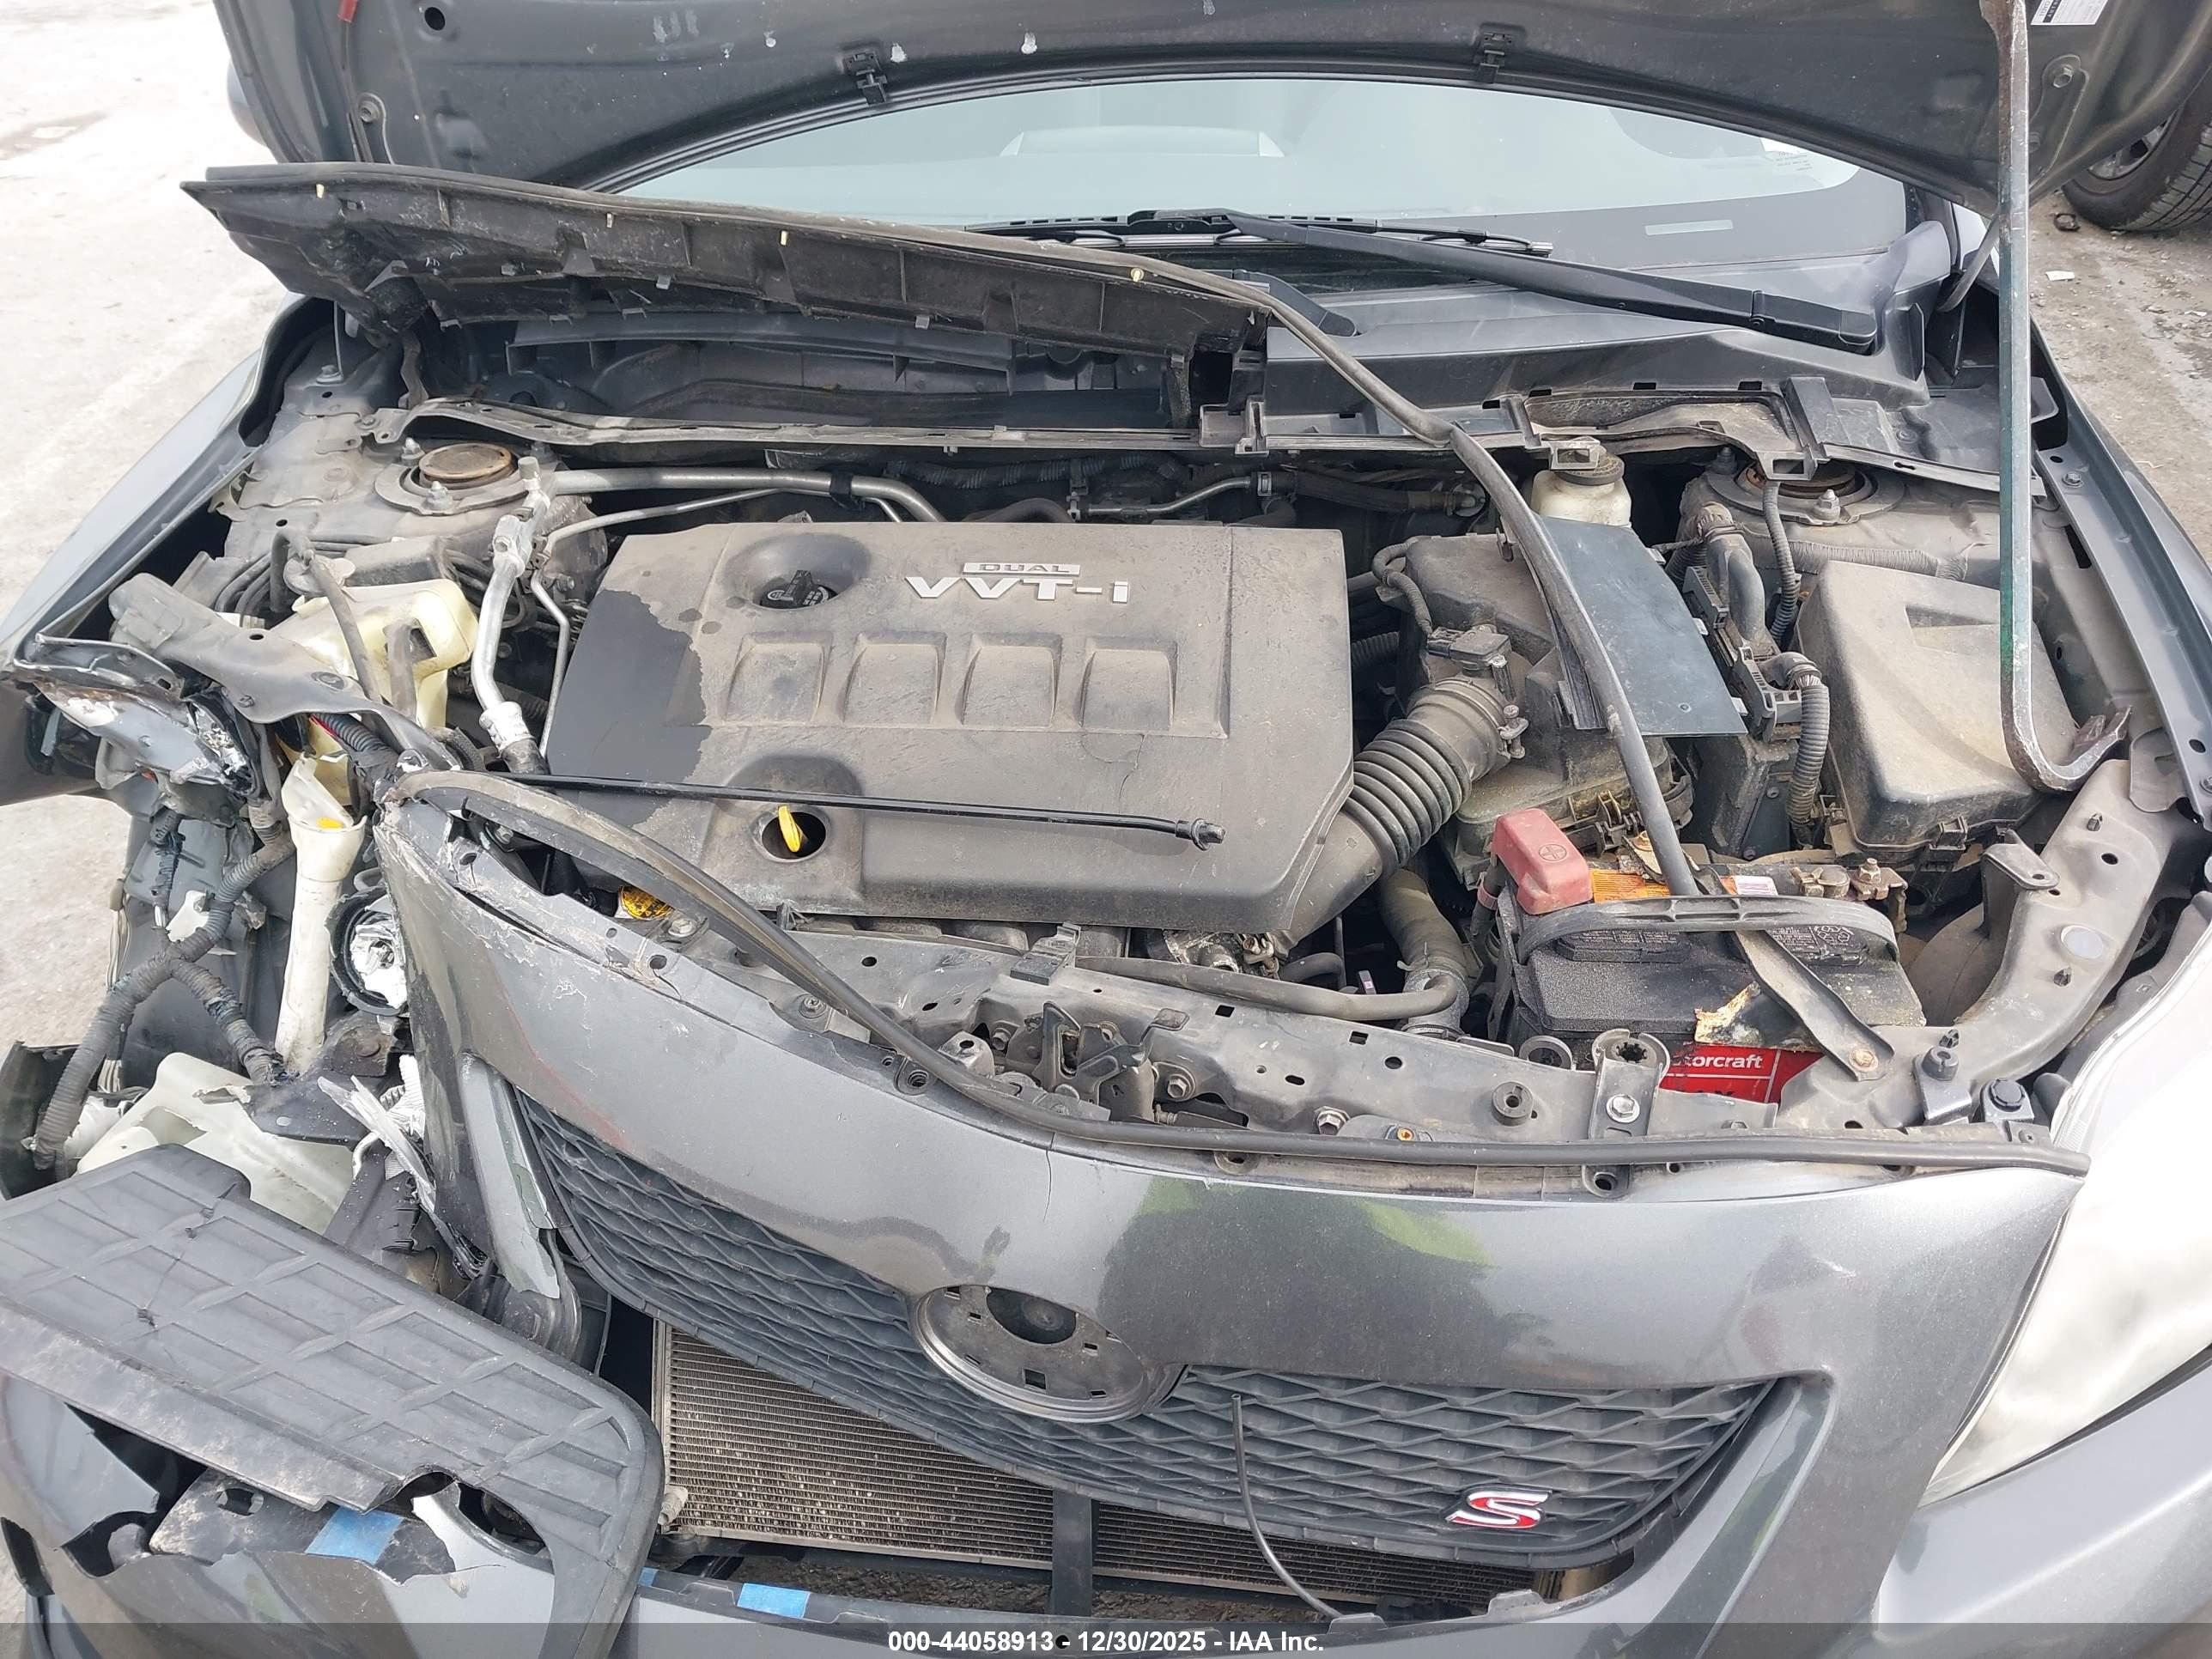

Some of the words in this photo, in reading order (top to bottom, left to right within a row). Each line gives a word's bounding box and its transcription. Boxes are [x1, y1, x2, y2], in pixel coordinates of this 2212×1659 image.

[976, 563, 1072, 574] DUAL
[904, 576, 1129, 603] VVT-i
[1444, 1491, 1549, 1528] S
